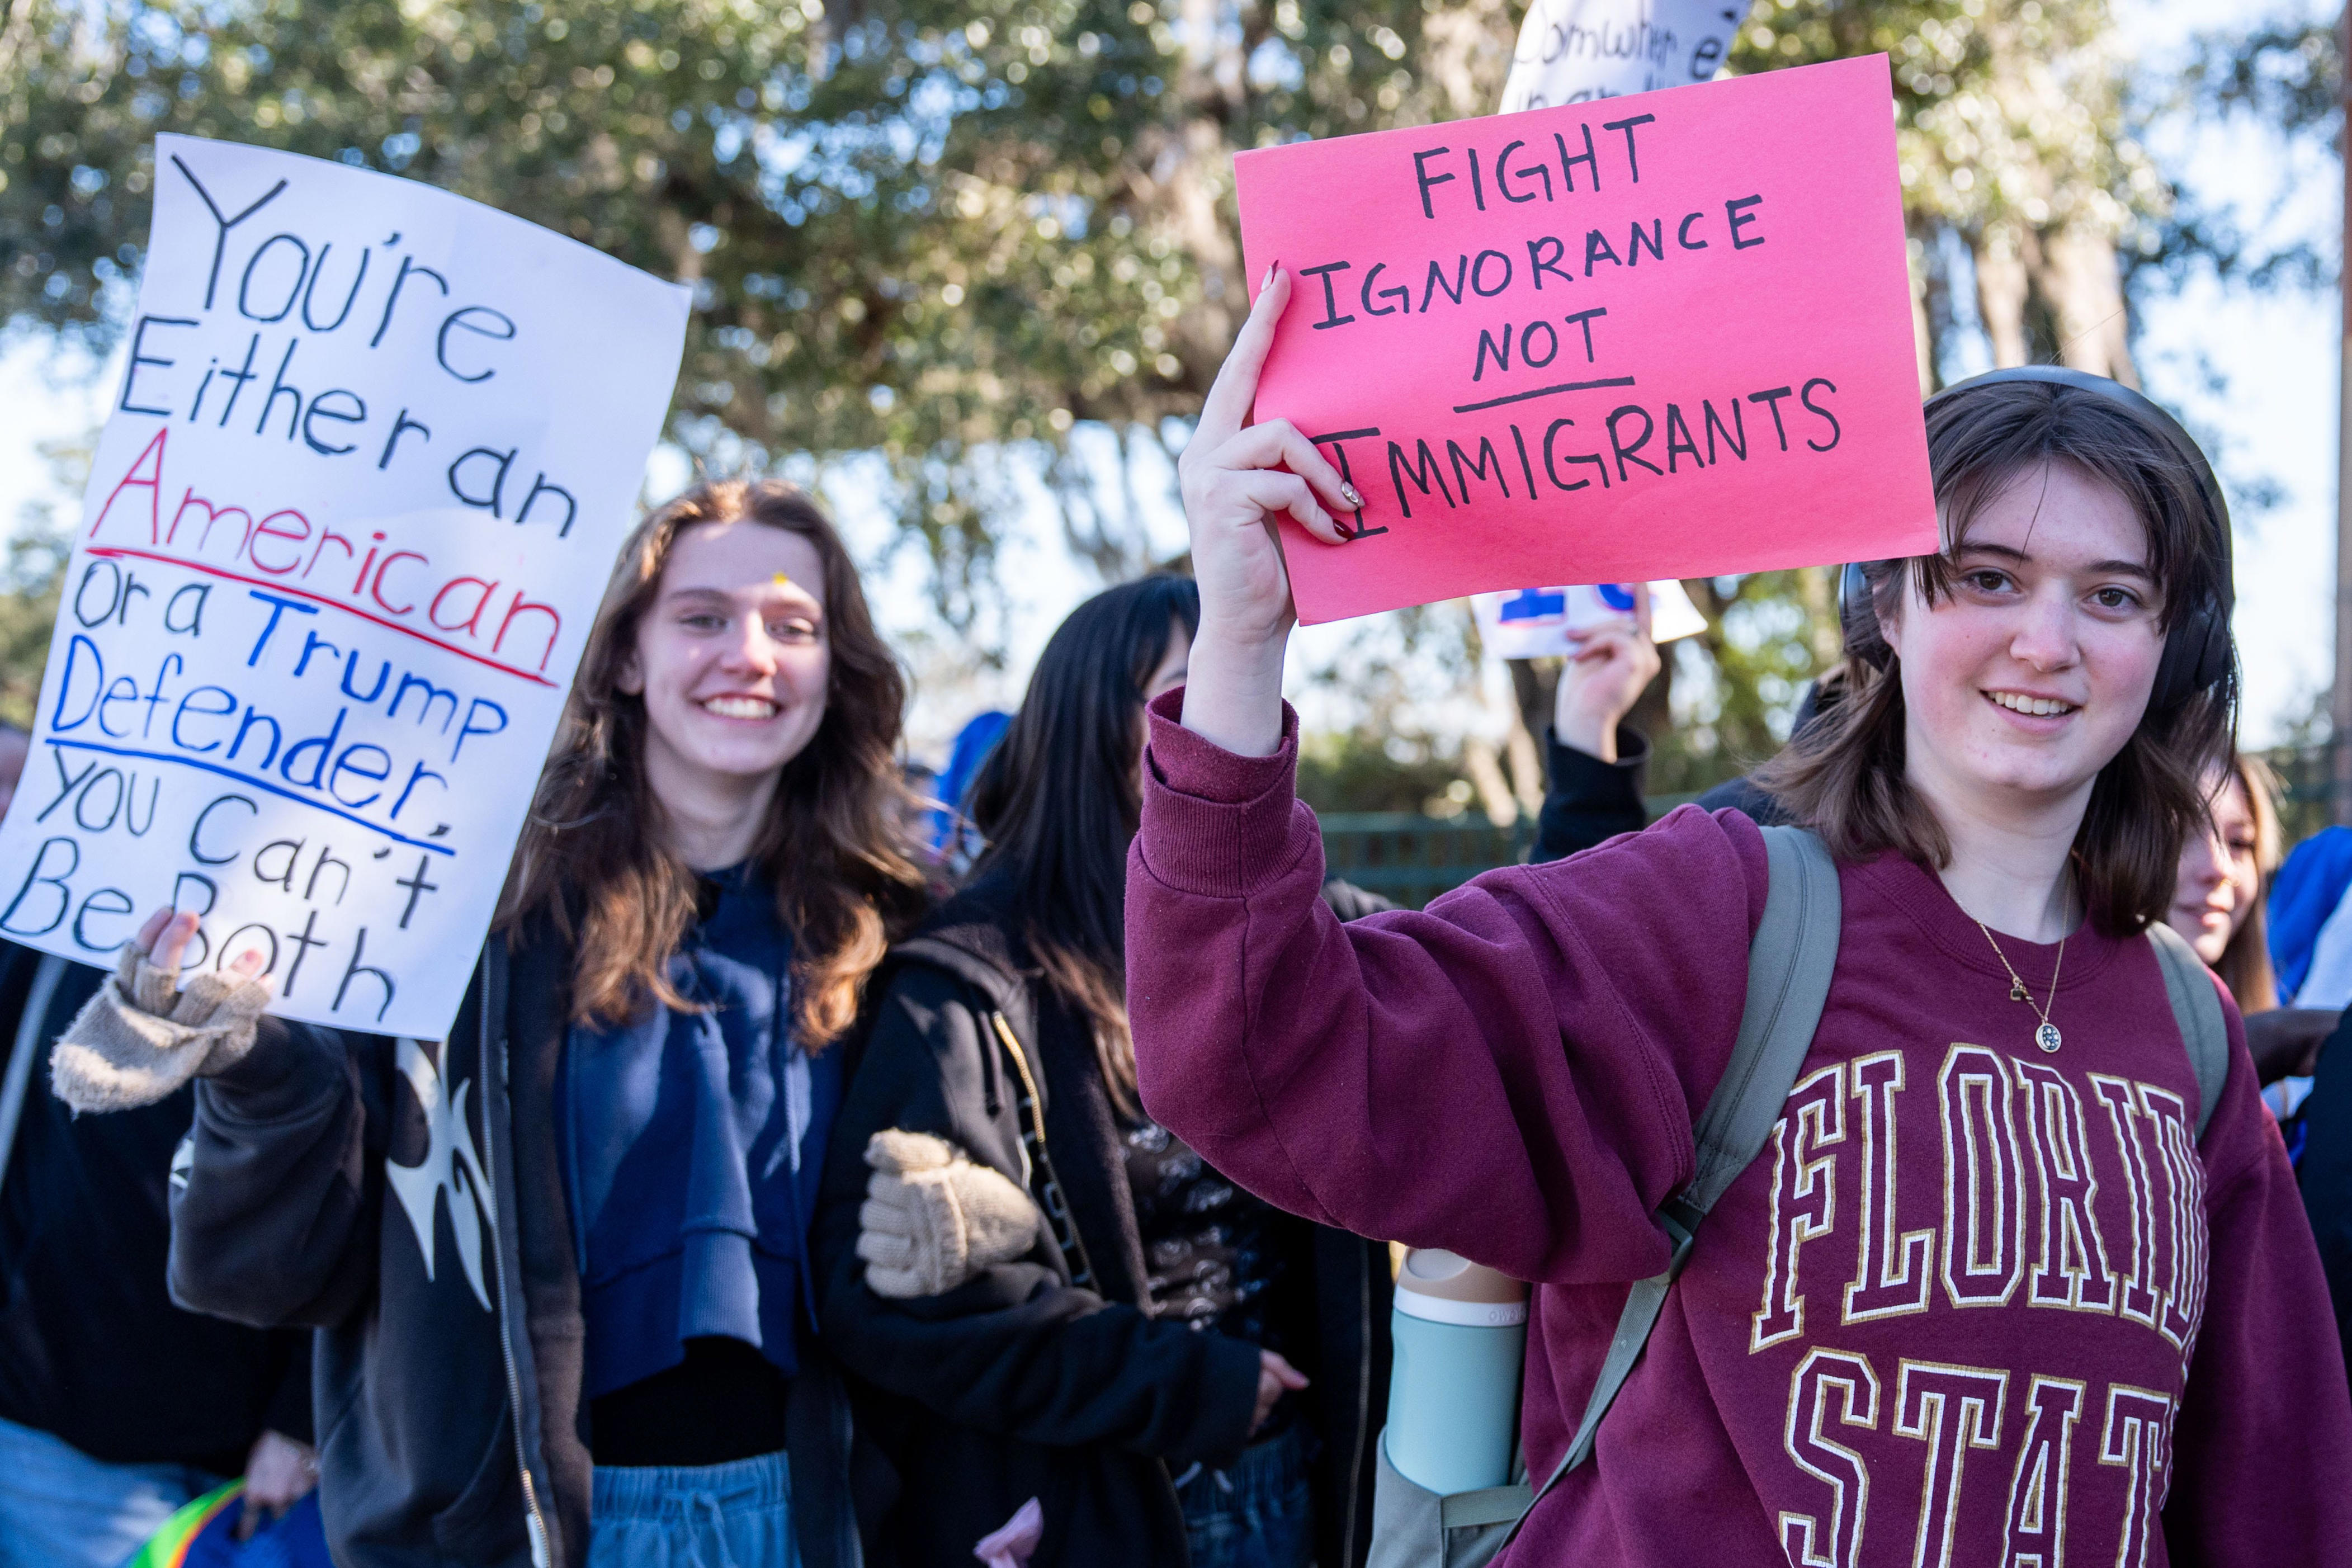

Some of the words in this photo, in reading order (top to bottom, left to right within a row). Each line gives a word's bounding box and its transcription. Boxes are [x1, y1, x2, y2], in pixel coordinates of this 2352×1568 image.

[1300, 194, 1765, 329] IGNORANCE
[1414, 114, 1655, 219] FIGHT
[171, 154, 516, 382] You're
[1472, 307, 1608, 382] NOT
[118, 315, 430, 470] Either
[448, 447, 578, 538] an
[1310, 378, 1841, 540] IMMIGRANTS
[89, 427, 560, 671] American
[51, 635, 454, 837] Defender,
[165, 582, 213, 637] a
[248, 590, 508, 764] Trump
[0, 837, 134, 953] Be
[173, 871, 396, 1023] Both
[1749, 1042, 2209, 1381] FLORID
[1779, 1345, 2179, 1568] STAT
